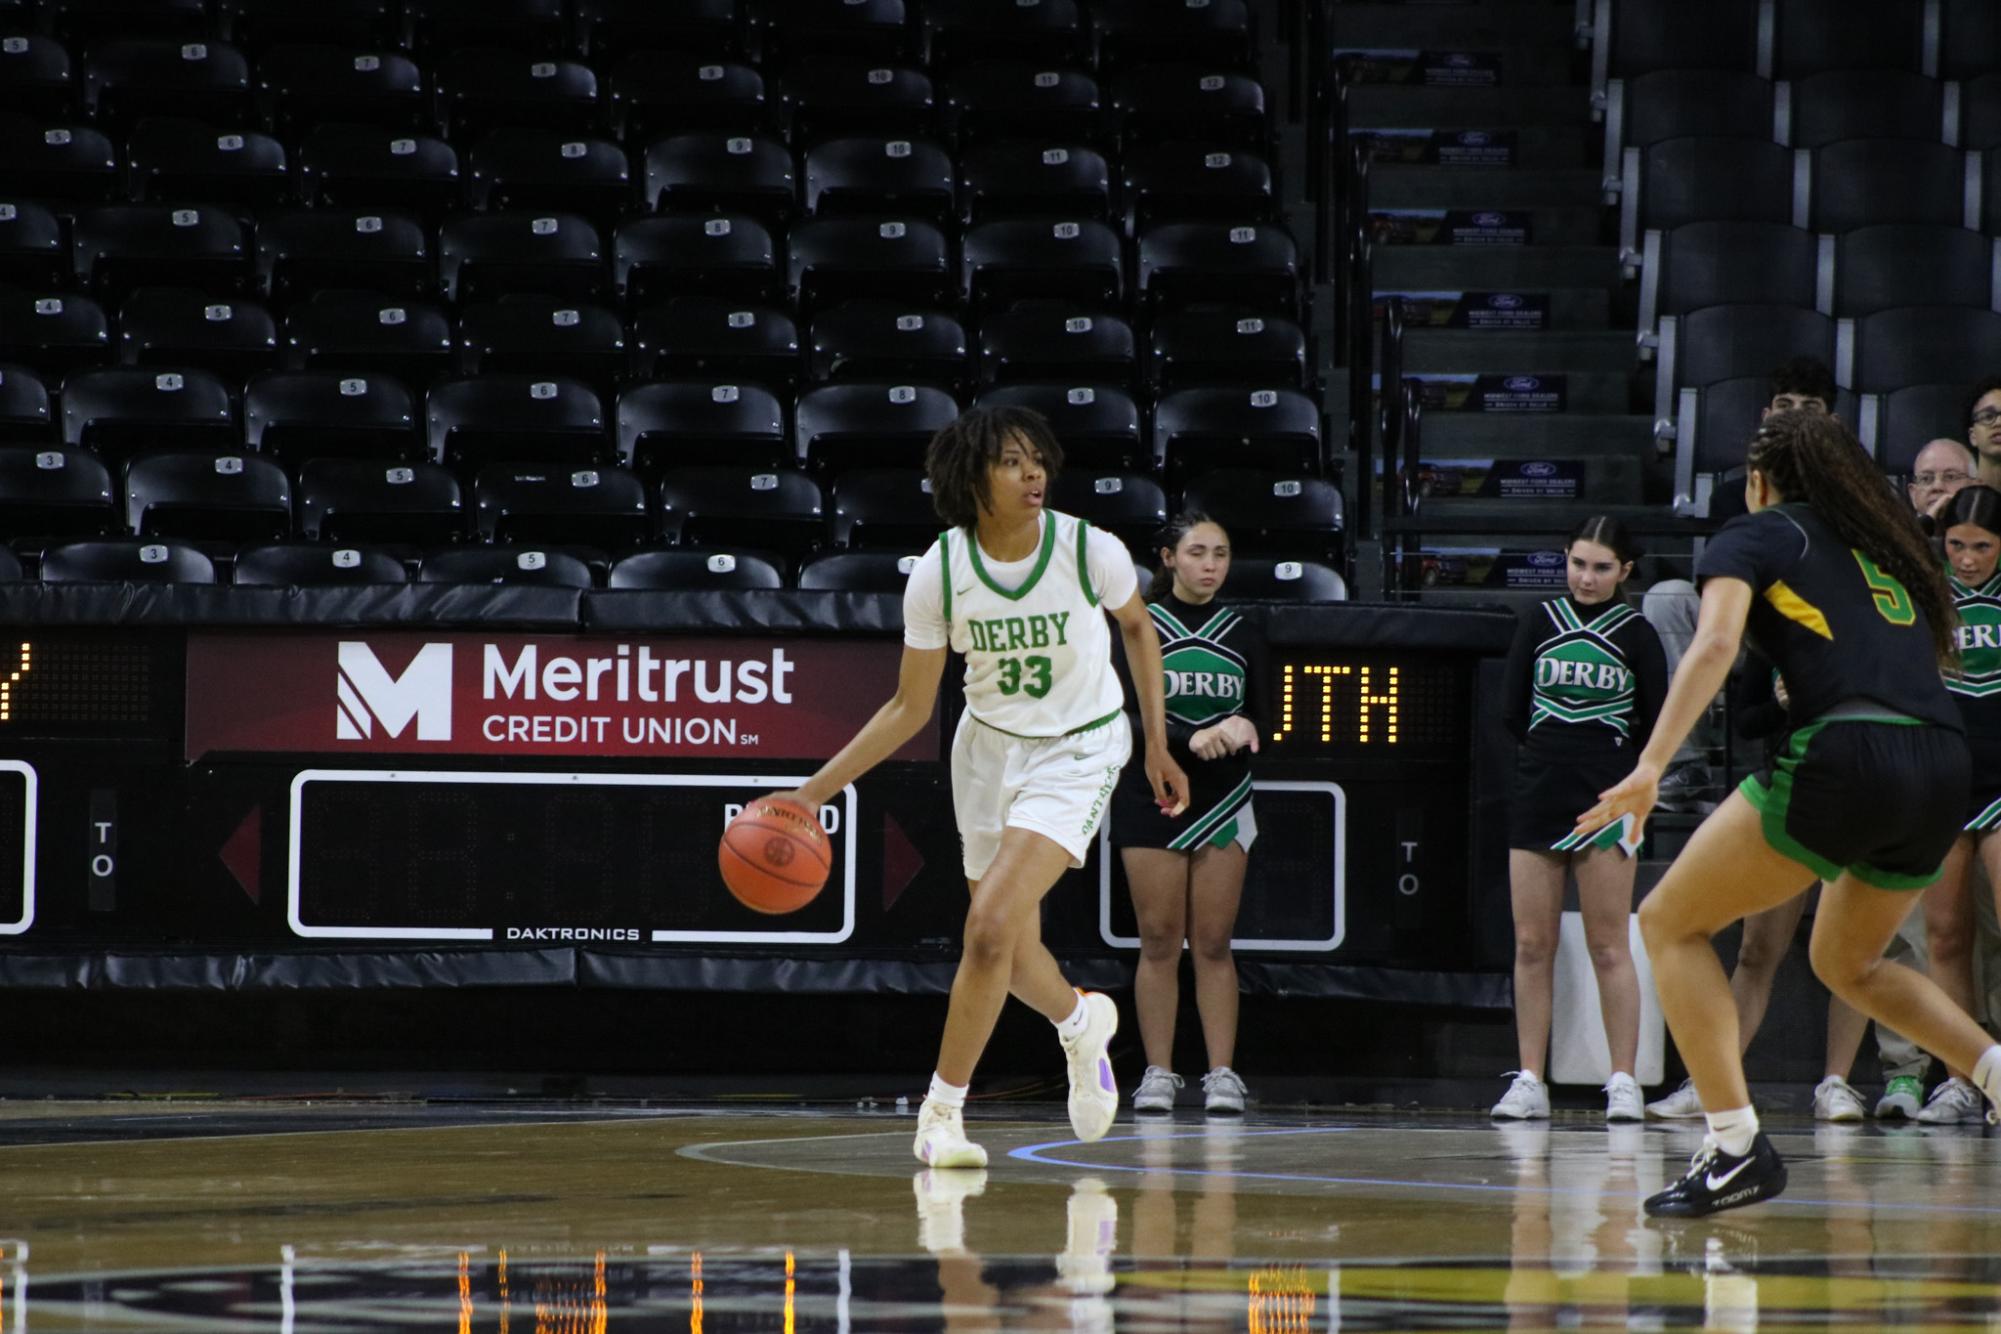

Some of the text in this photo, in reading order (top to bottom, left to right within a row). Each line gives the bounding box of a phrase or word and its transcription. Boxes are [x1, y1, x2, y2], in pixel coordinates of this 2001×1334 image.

[1042, 75, 1052, 84] 11
[1207, 78, 1218, 88] 12
[893, 144, 905, 155] 10
[1050, 151, 1060, 161] 11
[1212, 155, 1224, 165] 12
[1061, 225, 1073, 236] 10
[1237, 230, 1248, 240] 11
[1073, 319, 1085, 330] 10
[1244, 321, 1255, 331] 11
[1258, 393, 1271, 404] 10
[1281, 483, 1294, 494] 10
[1851, 548, 1916, 626] 5
[968, 611, 1070, 651] DERBY
[483, 644, 795, 704] Meritrust
[997, 655, 1052, 699] 33
[1536, 658, 1631, 692] DERBY
[483, 715, 611, 743] CREDIT
[622, 717, 736, 745] UNION
[507, 927, 640, 941] DAKTRONICS
